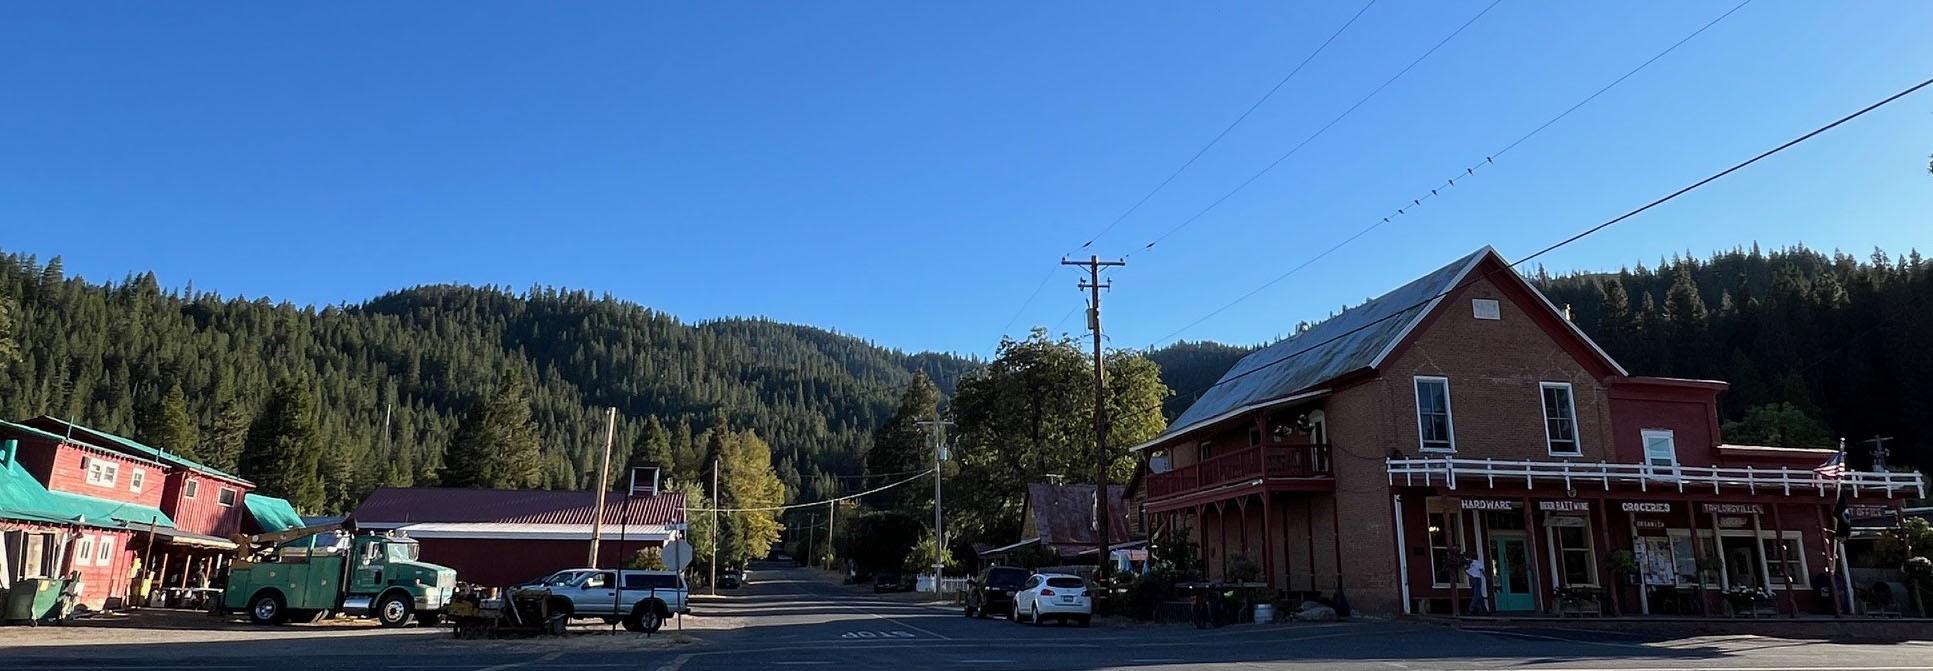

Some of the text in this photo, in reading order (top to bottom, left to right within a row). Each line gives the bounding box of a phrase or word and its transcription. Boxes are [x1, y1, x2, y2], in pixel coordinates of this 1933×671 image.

[1461, 499, 1512, 510] HARDWARE
[1621, 502, 1671, 513] GROCERIES
[1704, 503, 1758, 514] TAYLORSVILLE
[841, 631, 915, 639] STOP
